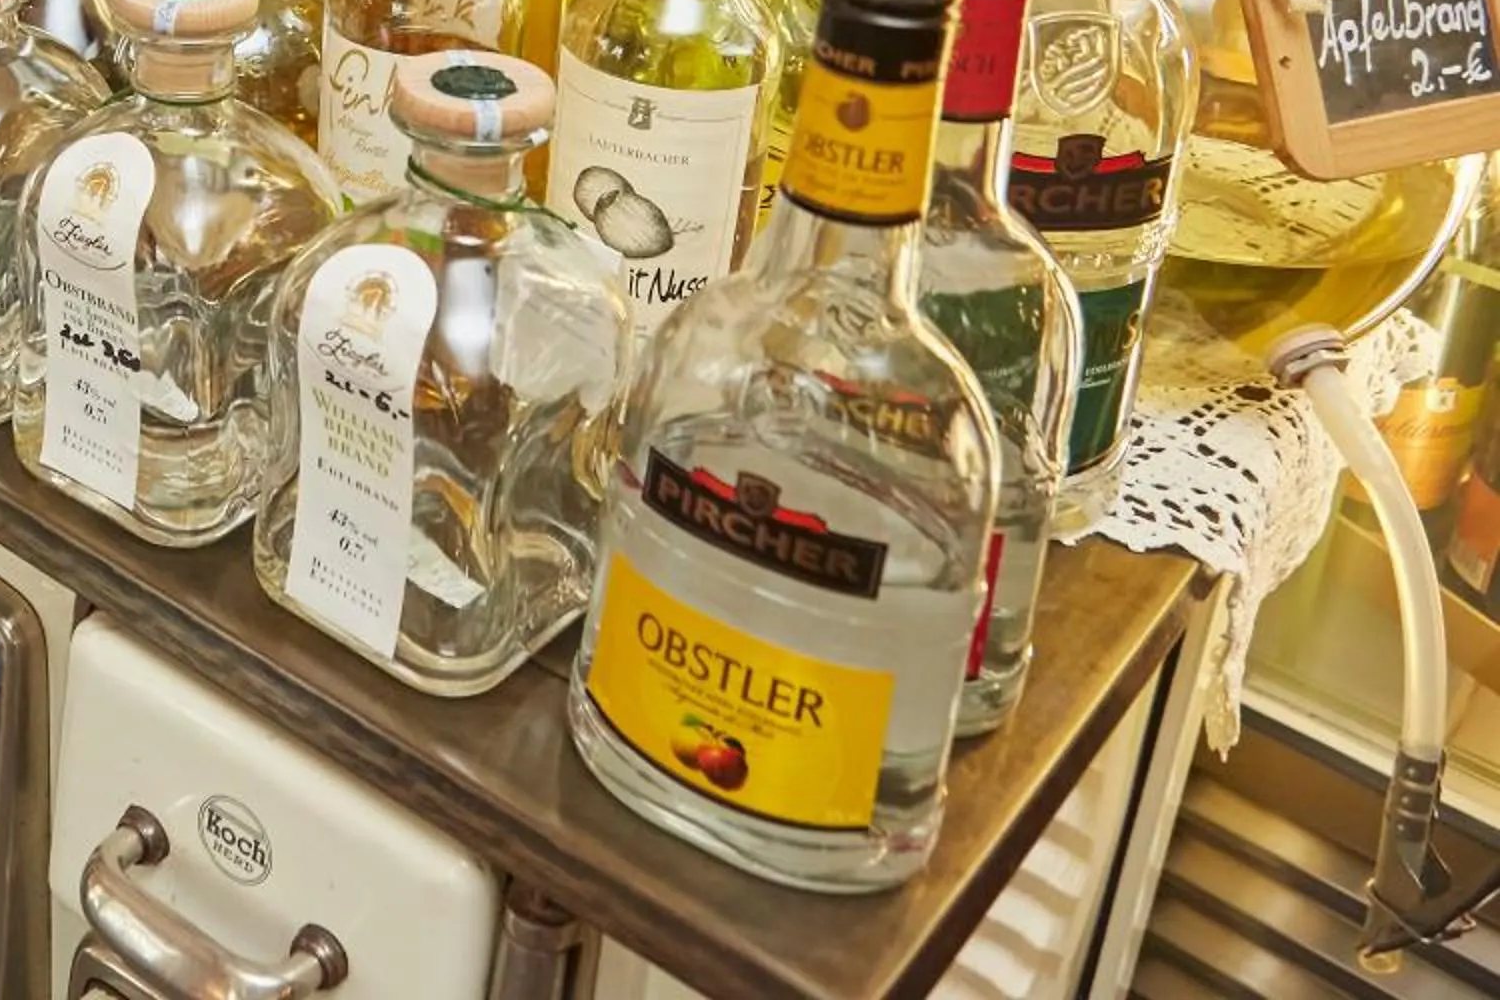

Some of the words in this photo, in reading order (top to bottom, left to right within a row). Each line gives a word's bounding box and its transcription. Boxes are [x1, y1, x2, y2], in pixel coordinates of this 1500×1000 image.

[588, 132, 692, 167] LAUTERBACHER
[45, 269, 136, 326] OBSTBRAND
[655, 473, 861, 584] PIRCHER
[636, 610, 825, 729] OBSTLER
[211, 839, 256, 874] HERD
